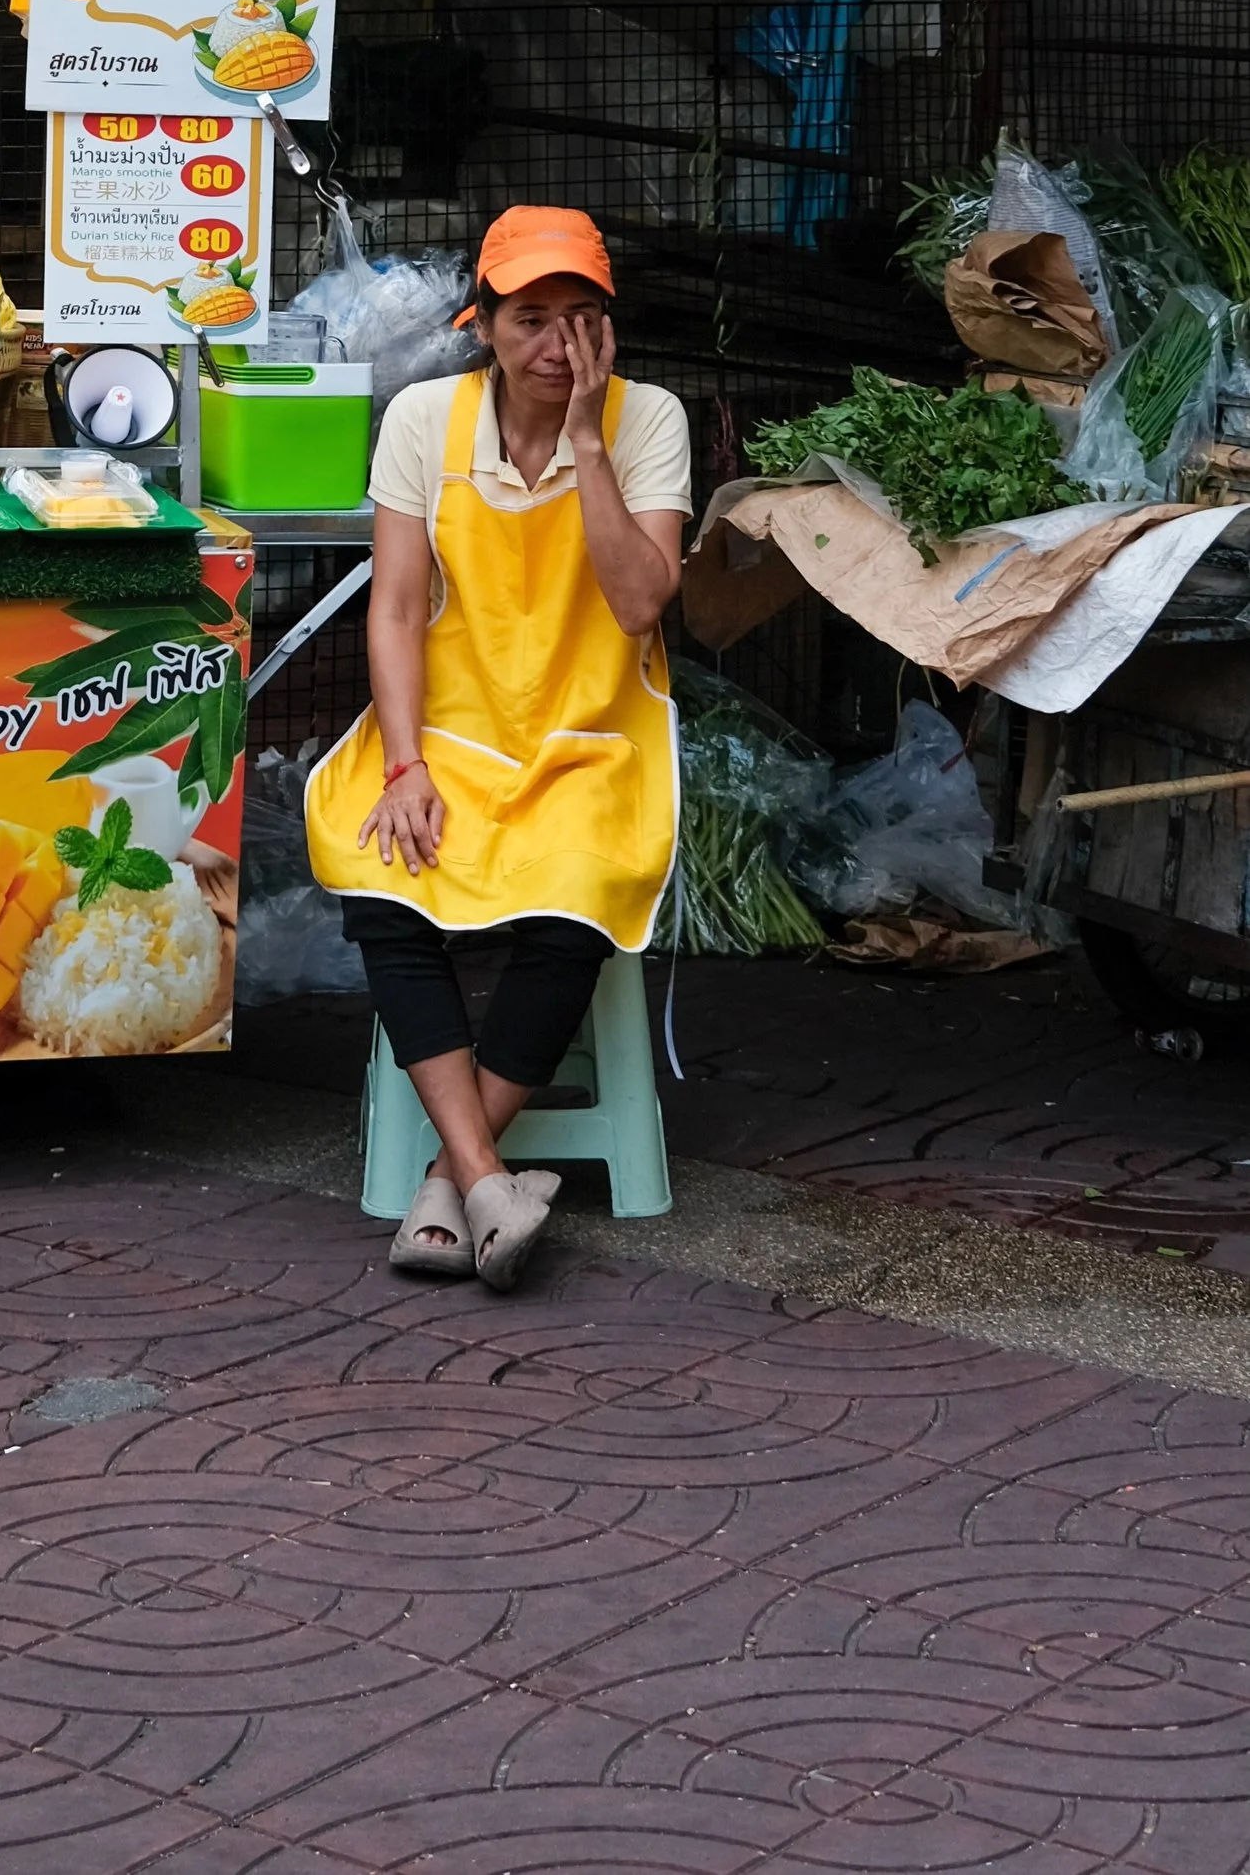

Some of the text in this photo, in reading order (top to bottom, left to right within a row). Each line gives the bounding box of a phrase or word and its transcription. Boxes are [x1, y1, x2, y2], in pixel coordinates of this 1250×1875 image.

[49, 46, 159, 78] สูตรโบราณ
[99, 116, 139, 141] 50
[179, 117, 219, 142] 80
[69, 137, 187, 166] น้ำมะม่วงปั่น
[72, 167, 174, 179] Mango smoothie
[190, 163, 233, 190] 60
[70, 180, 172, 202] 芒果冰沙
[70, 206, 180, 231] ข้าวเหนียวทุเรียน
[70, 230, 176, 243] Durian Sticky Rice
[189, 226, 232, 253] 80
[83, 243, 176, 263] 榴莲糯米饭
[59, 298, 142, 321] สูตรโบราณ
[23, 342, 45, 350] MENU
[25, 334, 43, 342] KIDS
